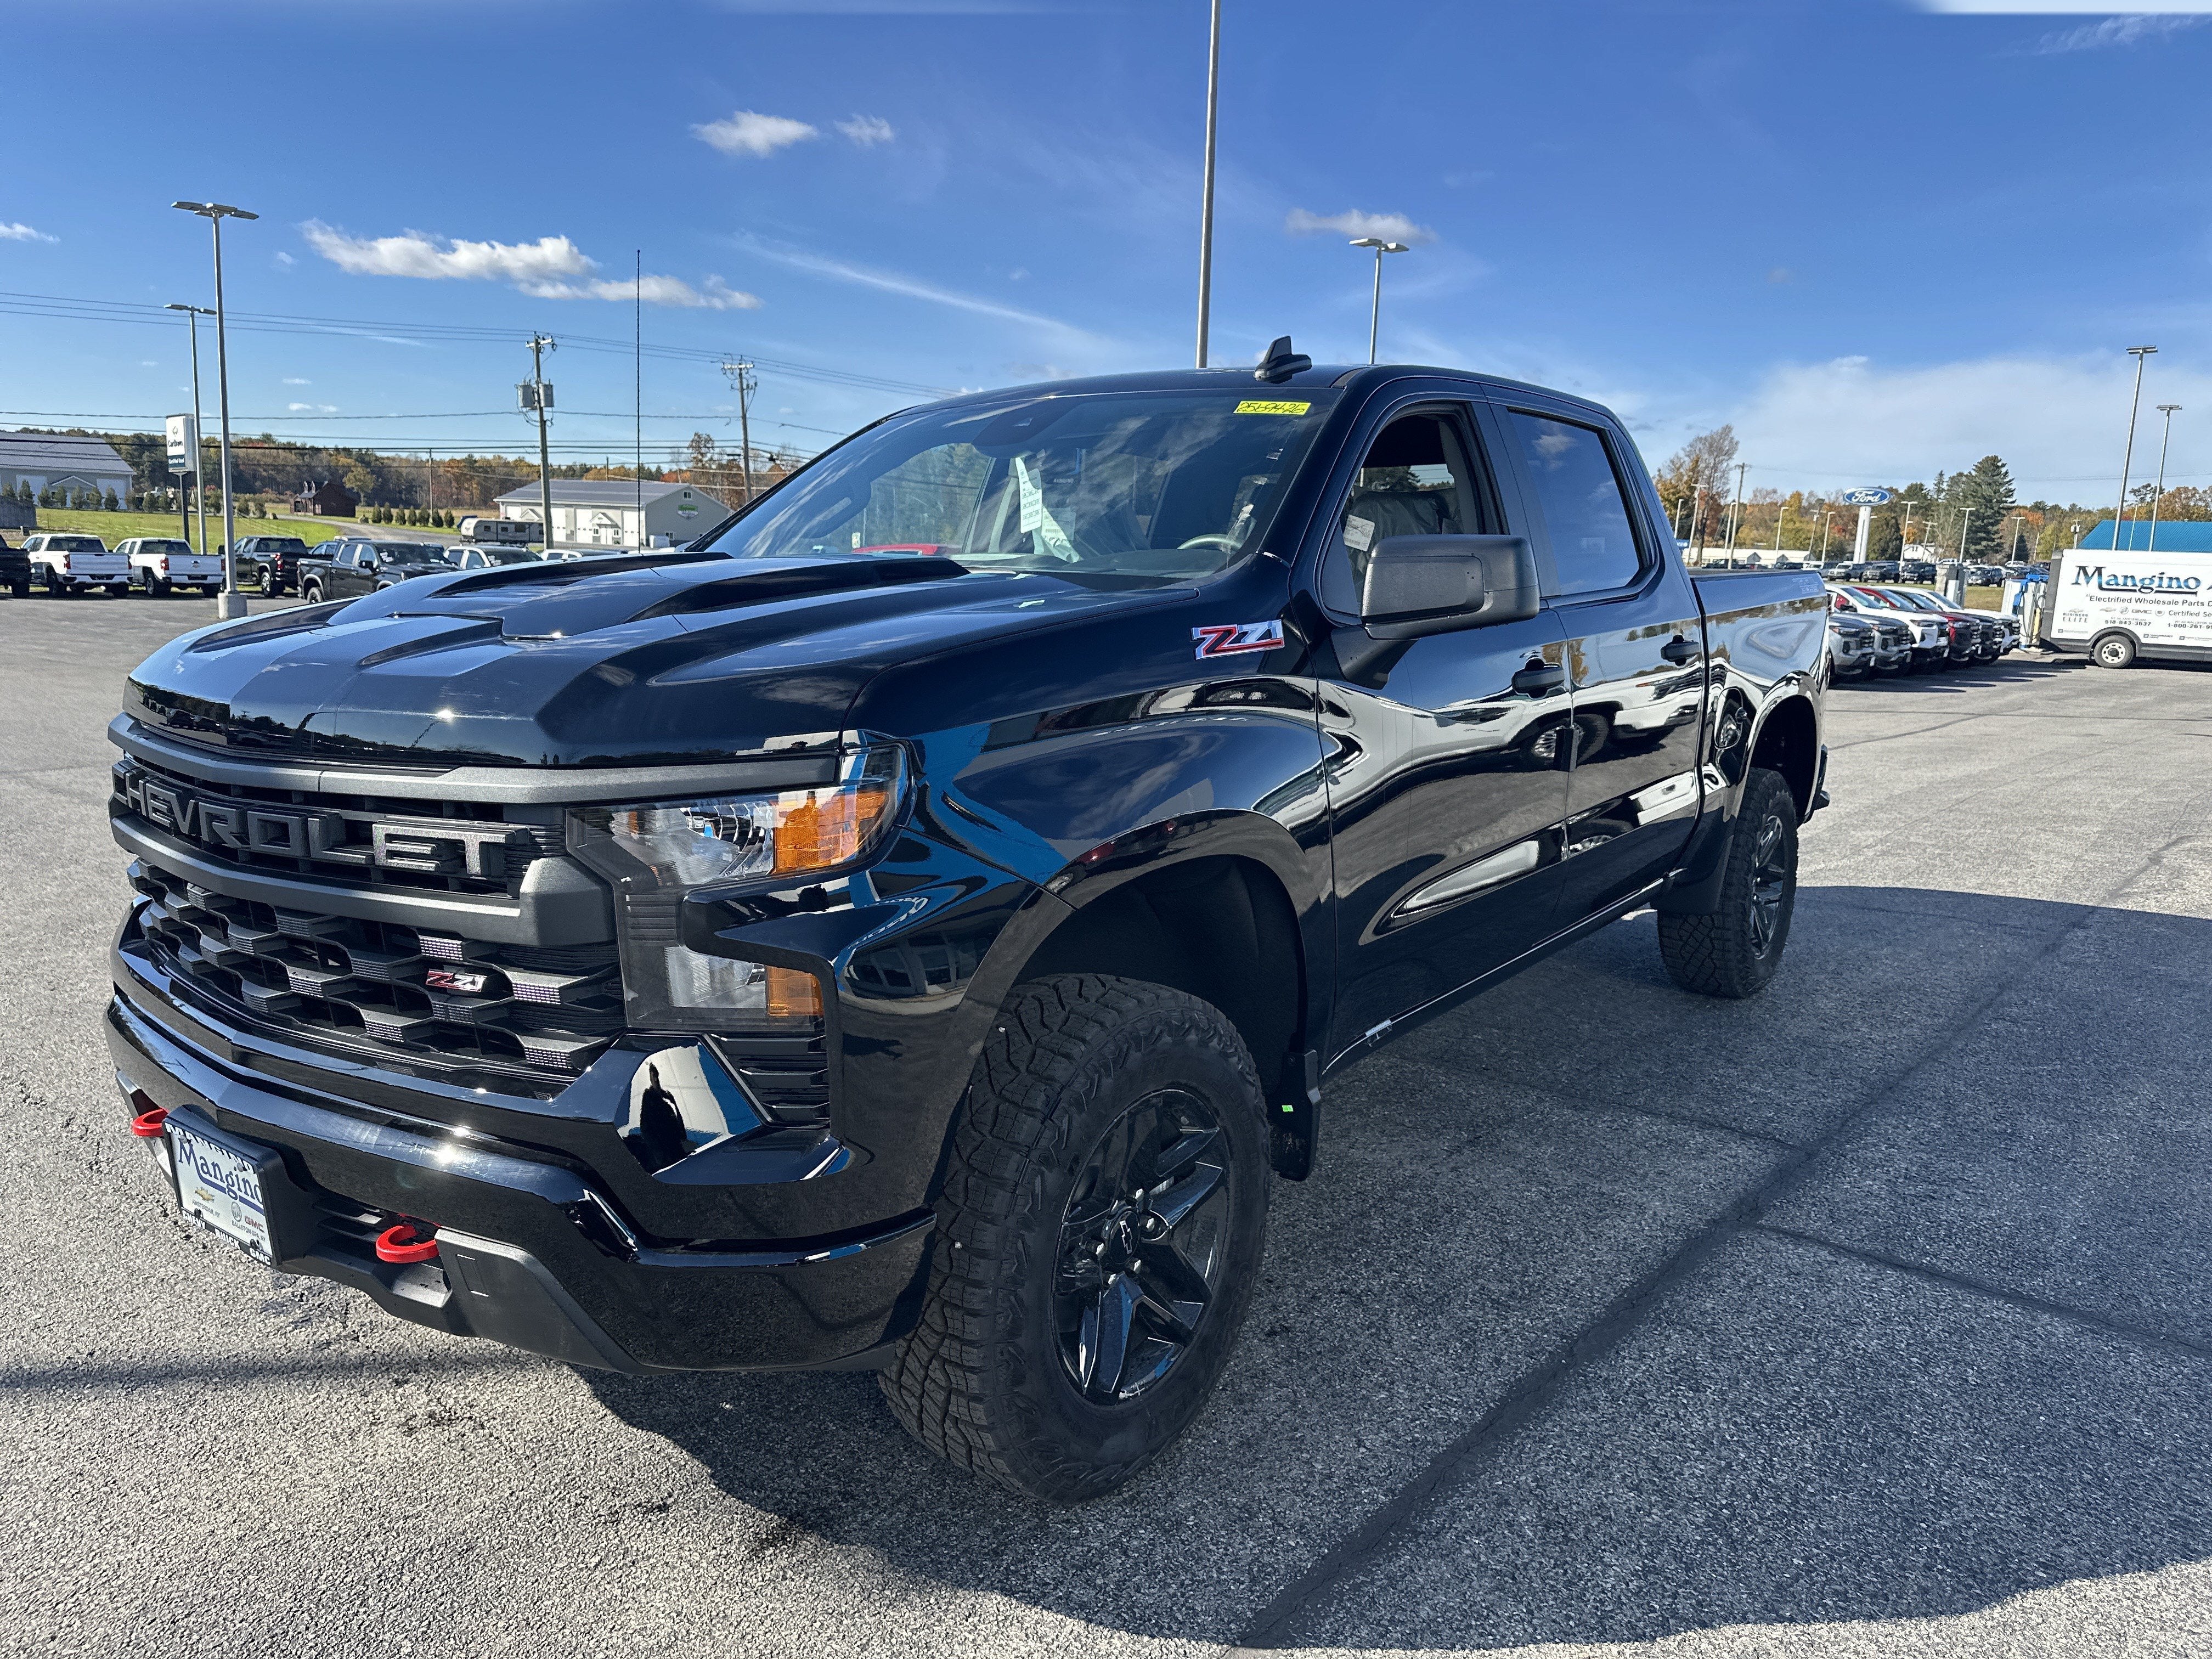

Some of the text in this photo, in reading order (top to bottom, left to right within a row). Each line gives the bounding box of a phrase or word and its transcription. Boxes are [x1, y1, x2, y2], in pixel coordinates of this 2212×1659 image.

[1852, 490, 1881, 503] Ford
[2070, 565, 2202, 595] Mangino
[2135, 597, 2179, 606] Wholesale
[2182, 599, 2204, 607] Parts
[1189, 619, 1286, 660] Z71
[111, 760, 530, 877] CHEVROLET
[425, 970, 487, 993] Z71
[178, 1137, 263, 1206] Mangino
[182, 1210, 206, 1229] CHEVY
[245, 1216, 265, 1233] GMC
[215, 1228, 240, 1250] BUICK
[249, 1248, 271, 1266] GMC
